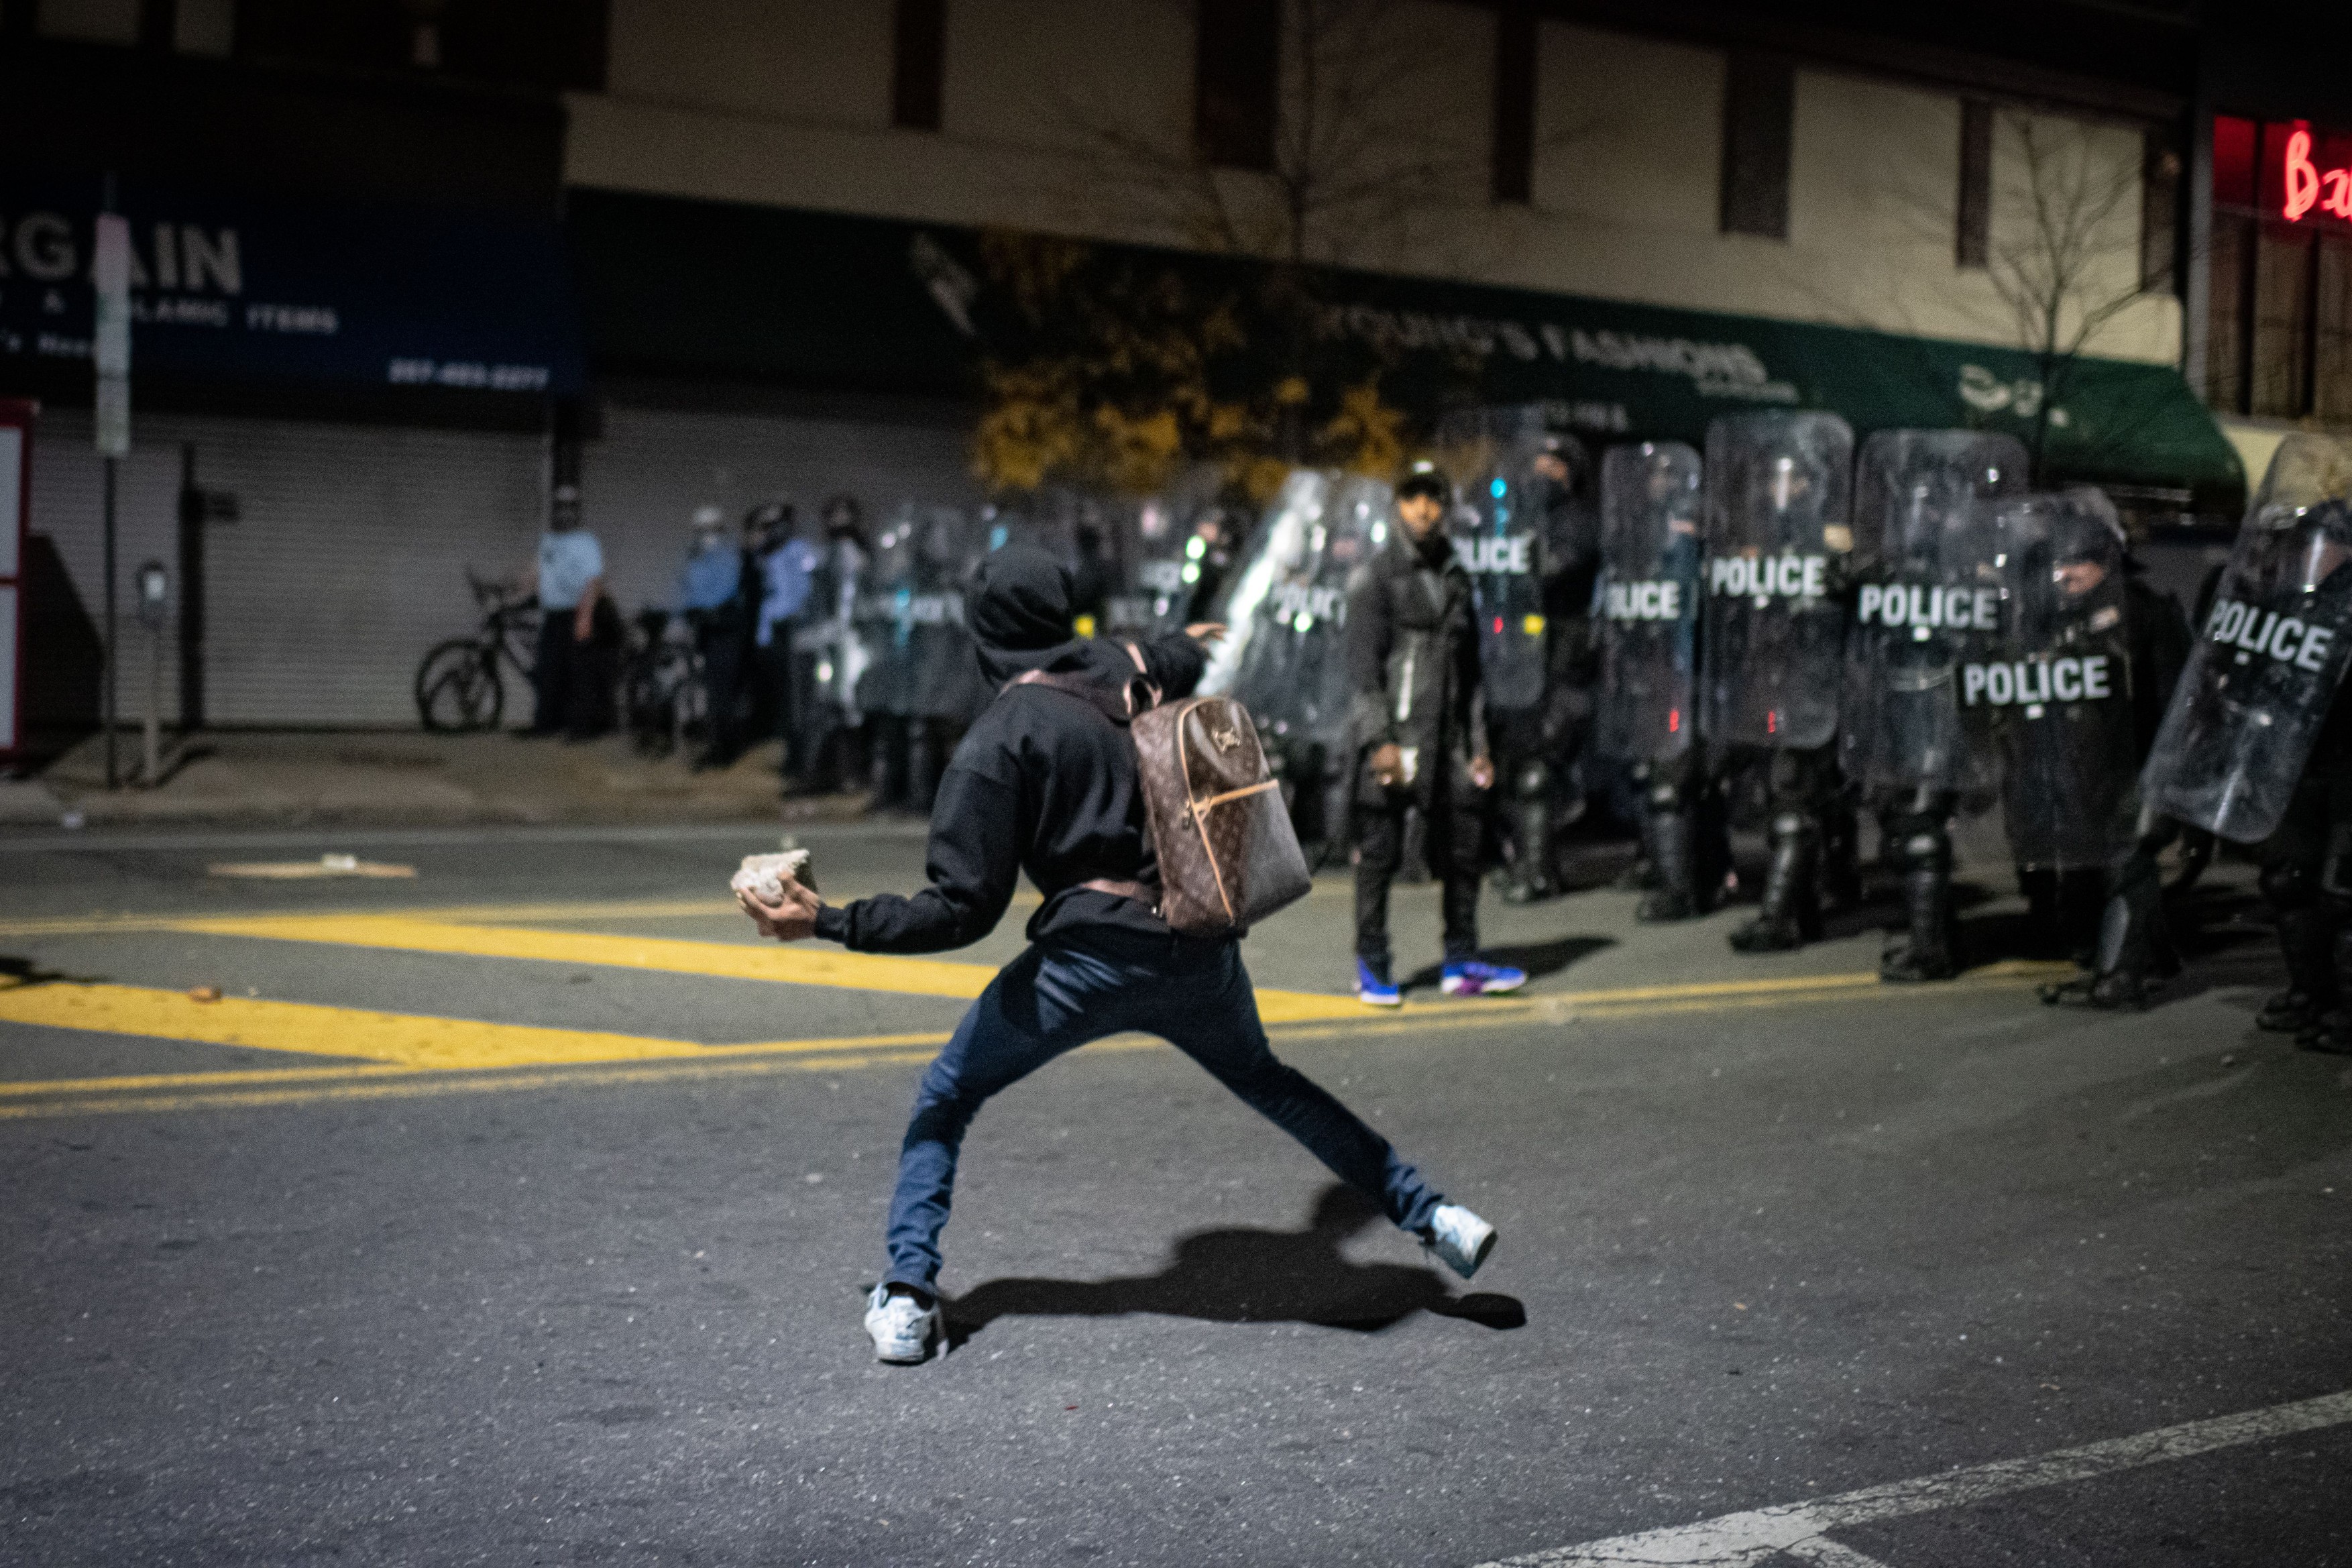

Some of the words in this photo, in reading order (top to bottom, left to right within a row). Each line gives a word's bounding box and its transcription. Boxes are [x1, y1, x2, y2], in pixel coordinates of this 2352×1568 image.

[0, 210, 243, 295] GIN
[1711, 555, 1826, 596] POLICE
[1858, 583, 1999, 630] POLICE
[2204, 598, 2335, 673] POLICE
[1962, 655, 2111, 706] POLICE
